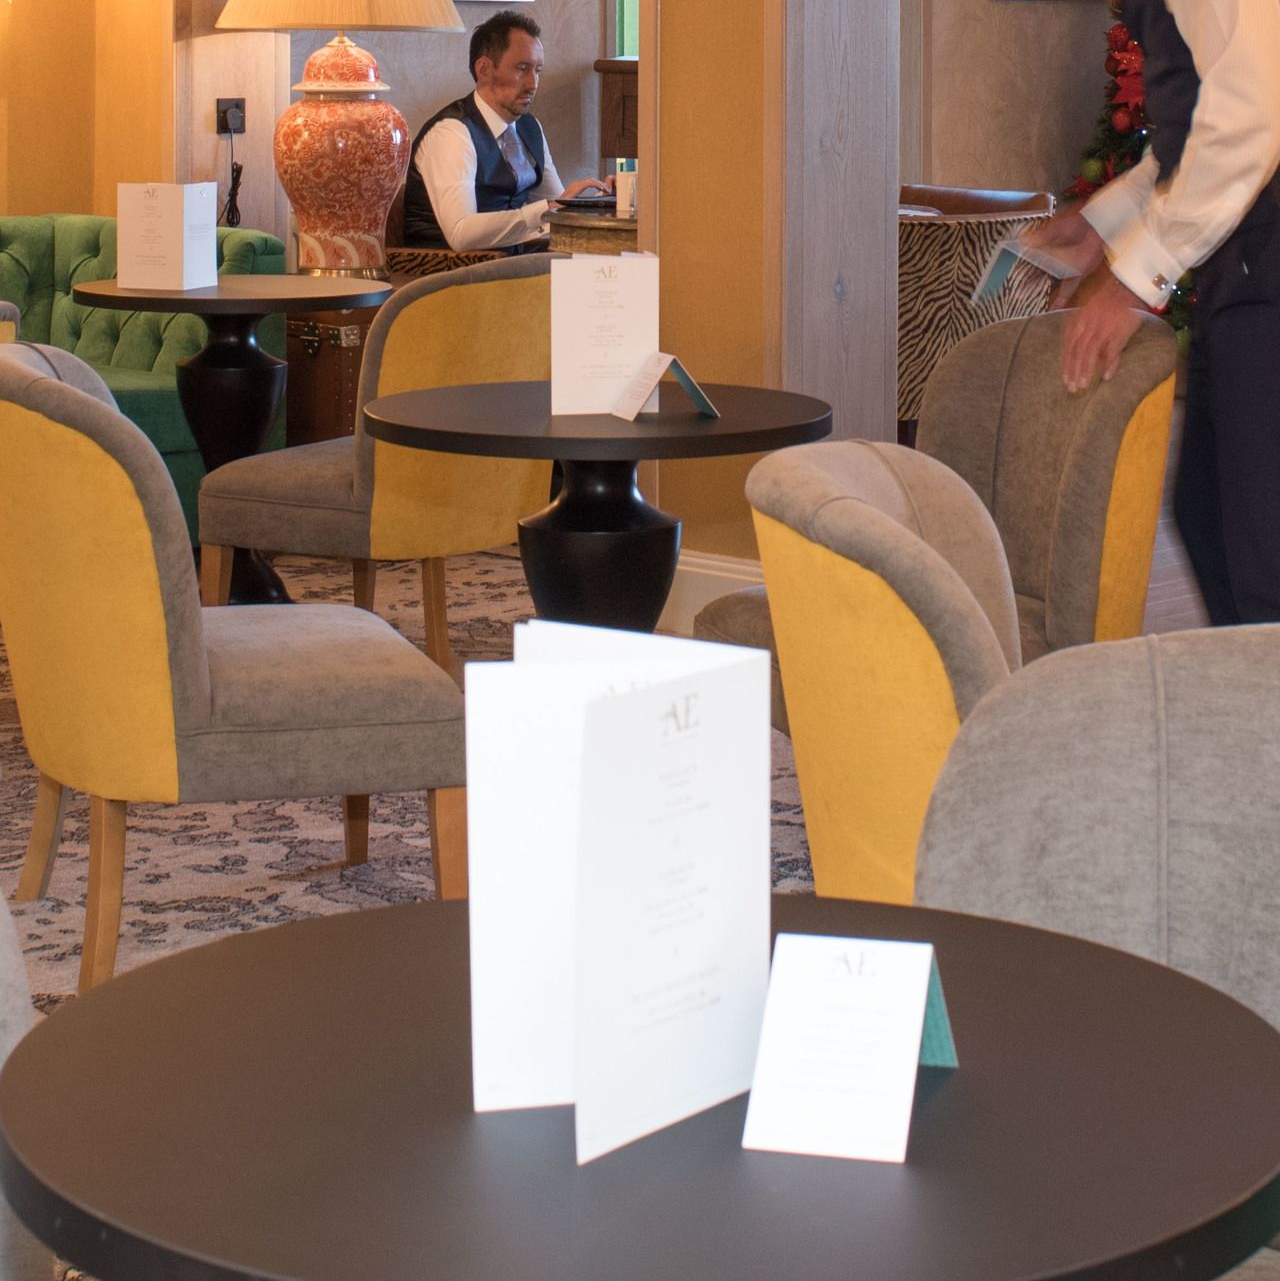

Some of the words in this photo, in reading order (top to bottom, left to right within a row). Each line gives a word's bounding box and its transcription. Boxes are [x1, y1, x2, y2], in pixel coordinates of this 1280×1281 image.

[593, 265, 618, 279] AE
[659, 691, 701, 736] AE
[827, 950, 877, 977] AE
